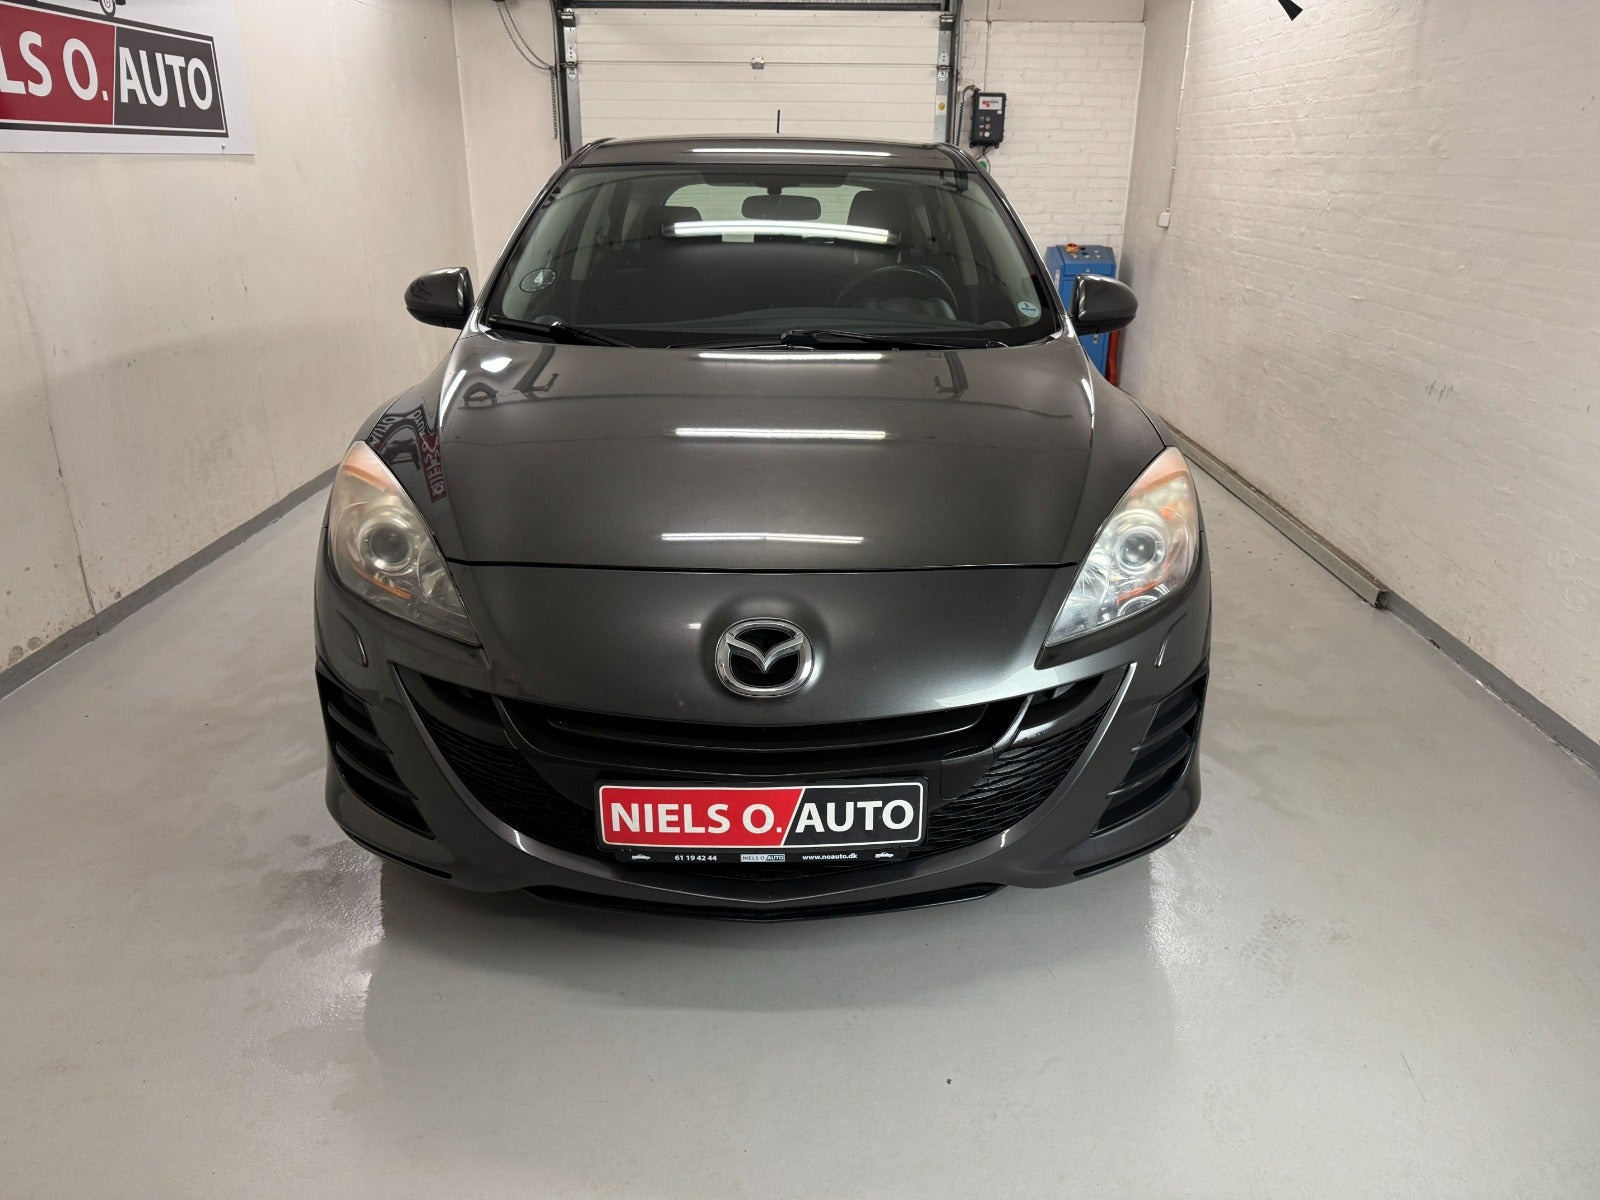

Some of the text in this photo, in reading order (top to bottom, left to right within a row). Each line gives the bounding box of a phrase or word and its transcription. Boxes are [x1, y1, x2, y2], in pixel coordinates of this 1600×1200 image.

[62, 37, 109, 101] O.
[118, 46, 213, 111] AUTO
[610, 799, 915, 834] NIELS O. AUTO
[802, 852, 858, 860] www.noauto.dk
